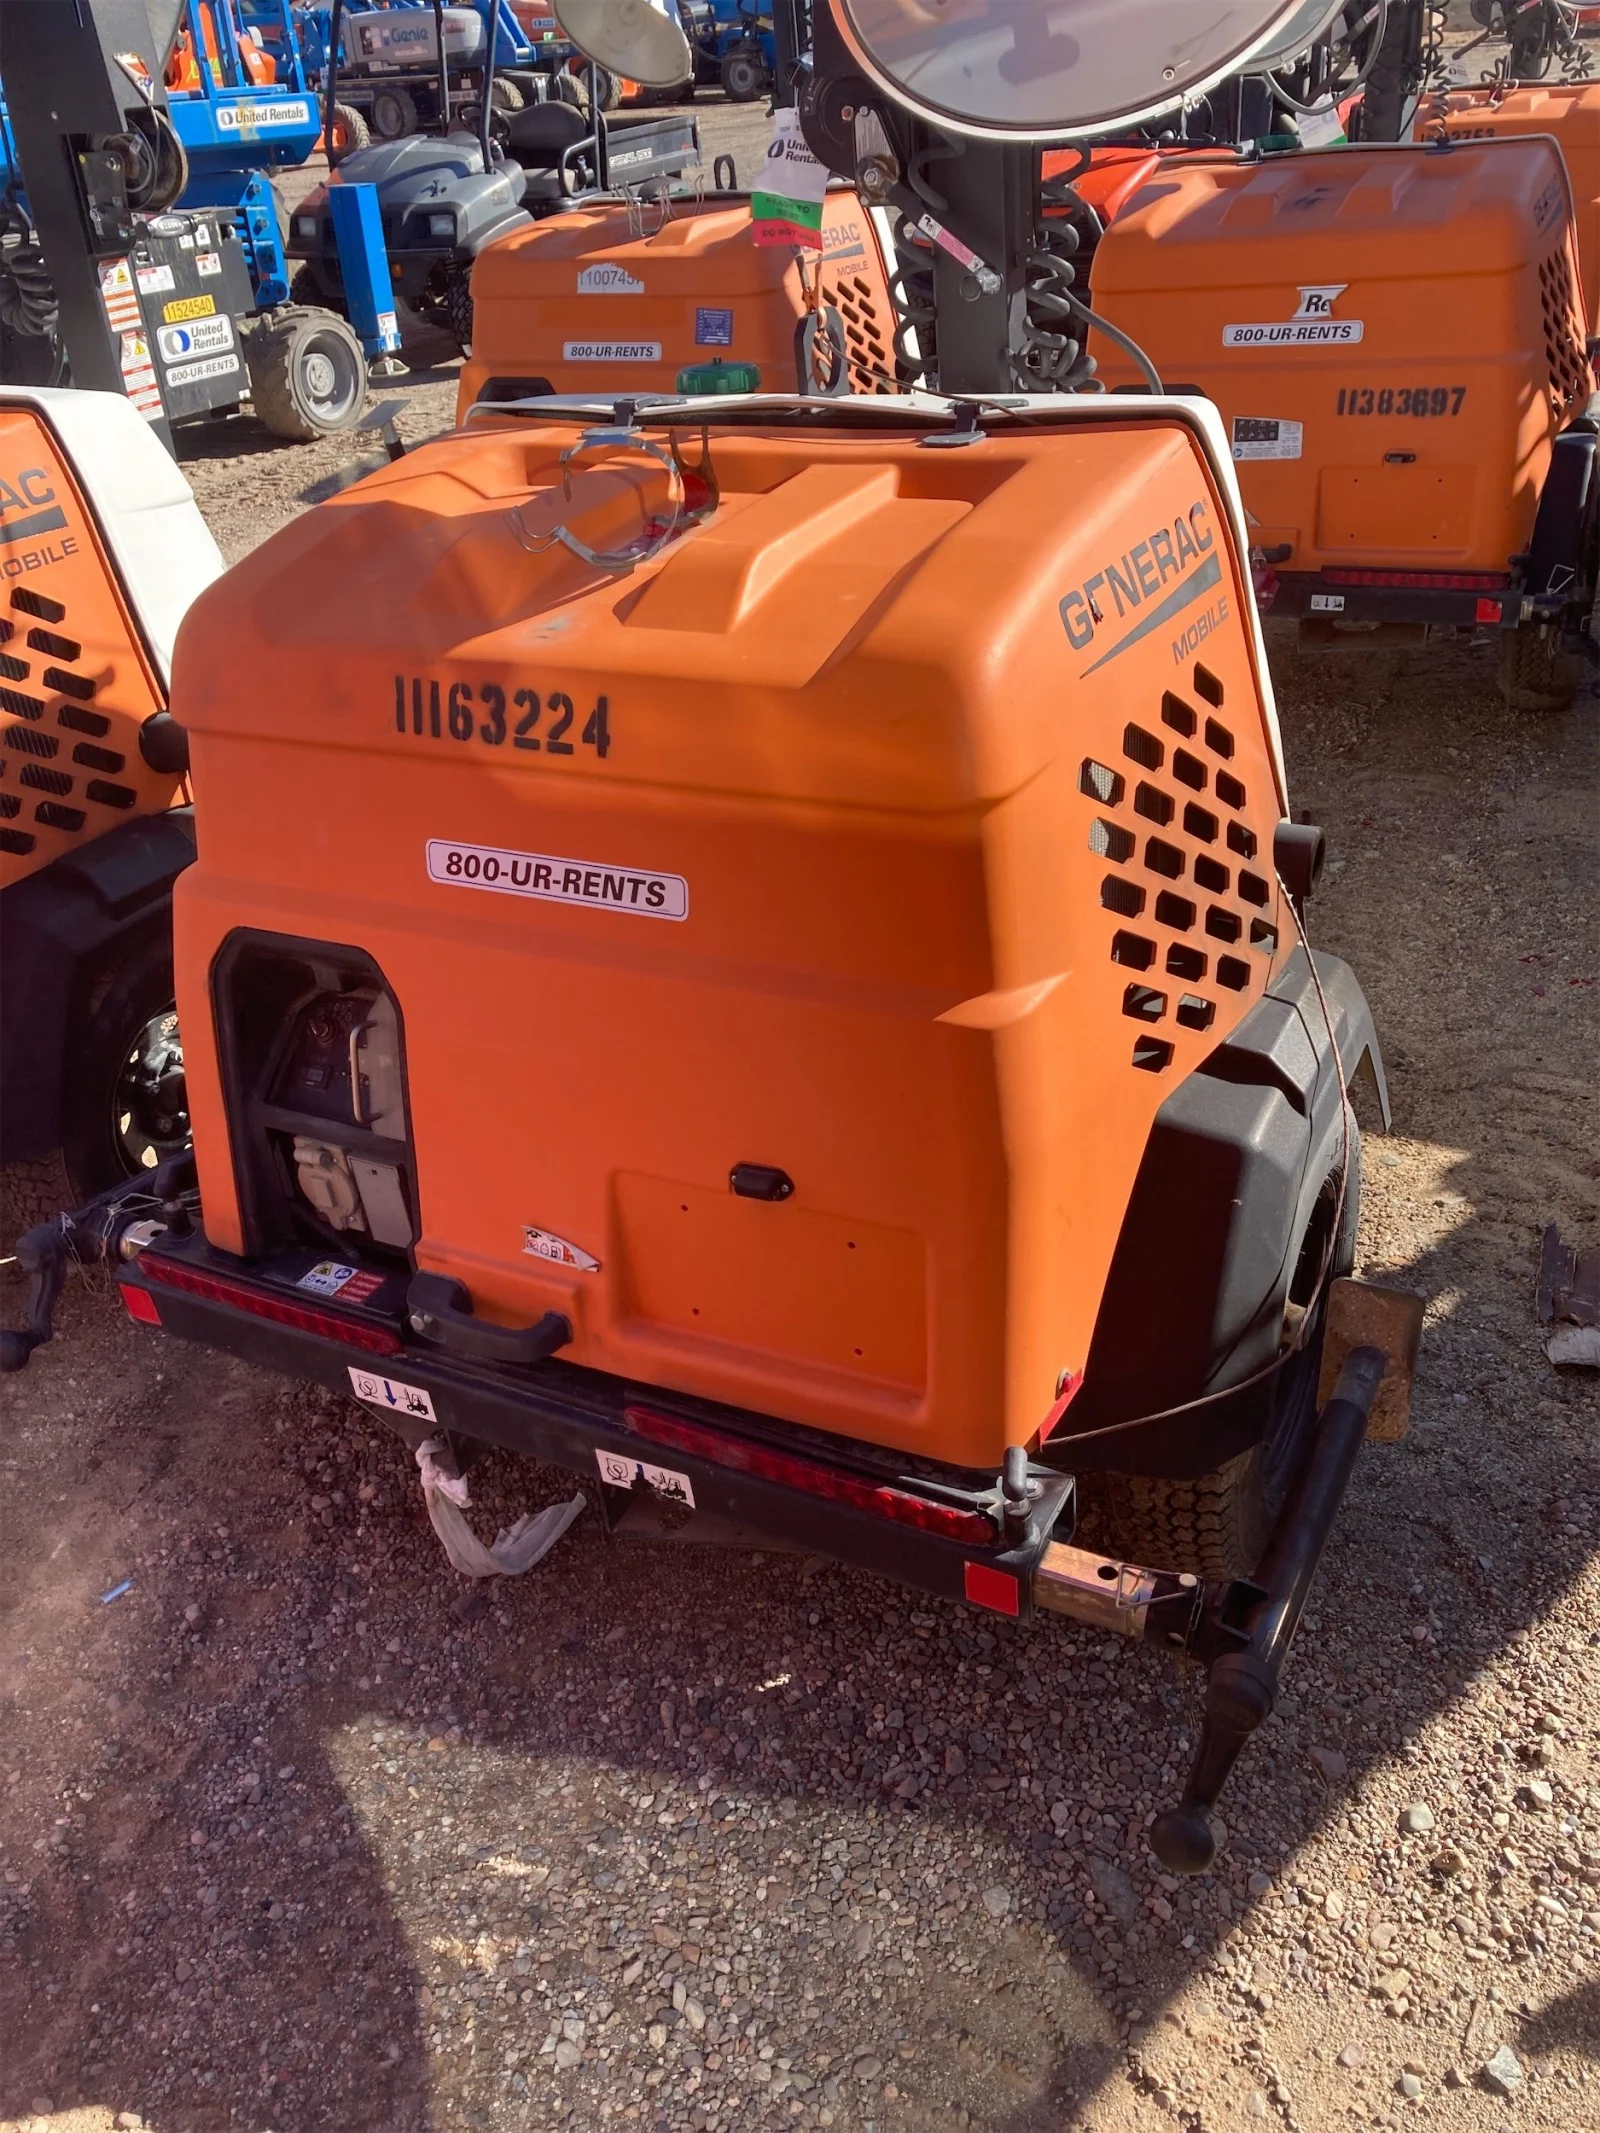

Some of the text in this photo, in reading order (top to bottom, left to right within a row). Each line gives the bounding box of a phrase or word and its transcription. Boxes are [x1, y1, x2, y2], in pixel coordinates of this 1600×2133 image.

[391, 27, 429, 43] Genie
[235, 106, 304, 123] United Rentals
[837, 260, 869, 277] MOBILE
[165, 297, 213, 321] 11524540
[191, 321, 223, 338] United
[1233, 325, 1352, 342] 800-UR-RENTS
[194, 334, 229, 350] Rentals
[570, 346, 654, 358] 800-UR-RENTS
[171, 358, 235, 382] 800-UR-RENTS
[1336, 387, 1467, 417] 11383697
[0, 537, 79, 580] OBILE
[1171, 595, 1230, 665] MOBILE
[394, 675, 611, 759] 11163224
[445, 851, 667, 908] 800-UR-RENTS
